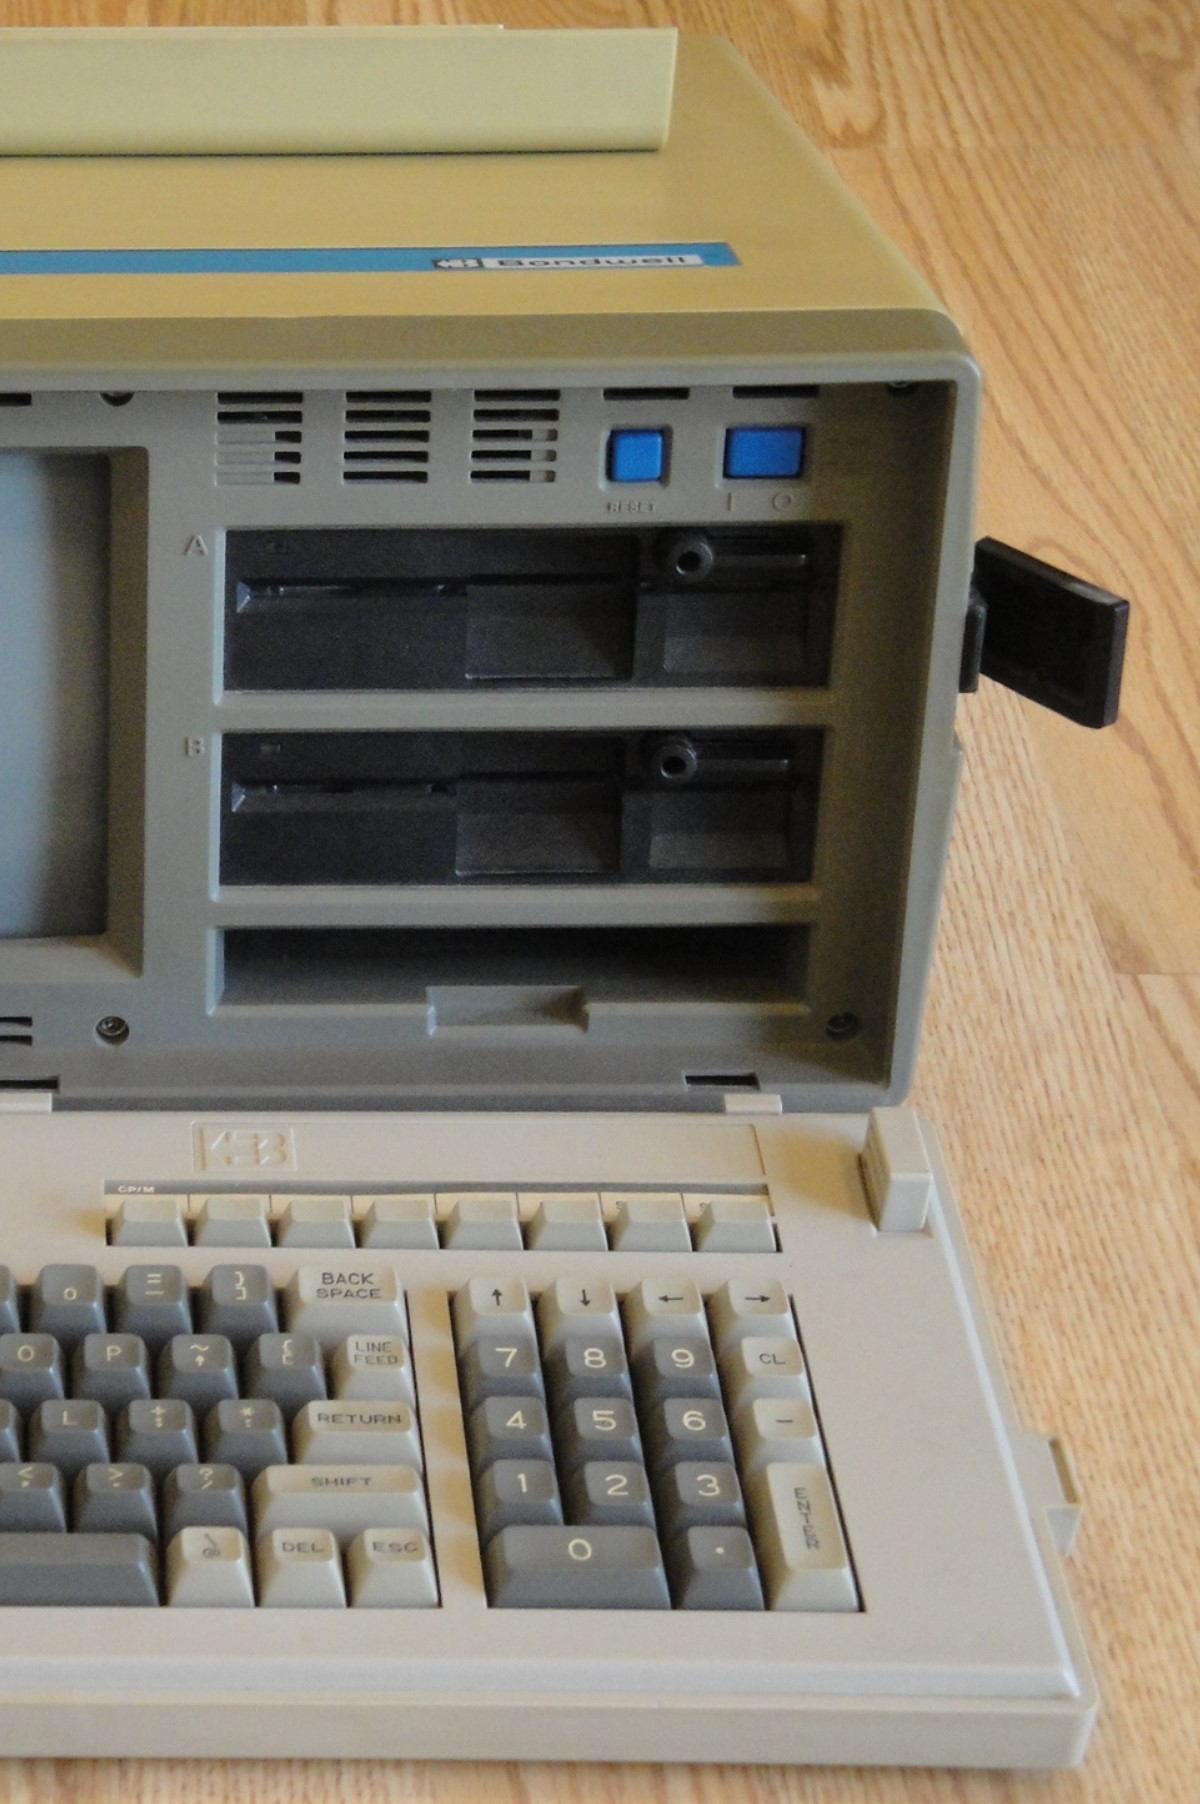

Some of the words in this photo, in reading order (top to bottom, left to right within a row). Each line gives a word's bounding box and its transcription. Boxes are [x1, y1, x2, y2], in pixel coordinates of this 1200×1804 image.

[497, 255, 686, 267] Bondwell
[606, 501, 657, 513] RESET
[184, 535, 209, 557] A
[184, 736, 205, 758] B
[117, 1185, 155, 1194] CP/M
[321, 1273, 374, 1285] BACK
[317, 1288, 382, 1299] SPACE
[105, 1345, 122, 1362] P
[355, 1342, 392, 1353] LINE
[354, 1355, 398, 1365] FEED
[495, 1347, 518, 1368] 7
[583, 1348, 607, 1368] 8
[671, 1349, 695, 1369] 9
[759, 1353, 787, 1365] CL
[63, 1411, 78, 1427] L
[317, 1412, 401, 1425] RETURN
[506, 1411, 527, 1429] 4
[592, 1411, 617, 1430] 5
[682, 1411, 706, 1430] 6
[311, 1477, 372, 1487] SHIFT
[517, 1473, 528, 1493] 1
[605, 1474, 628, 1495] 2
[697, 1474, 721, 1496] 3
[282, 1541, 323, 1552] DEL
[373, 1541, 417, 1552] ESC
